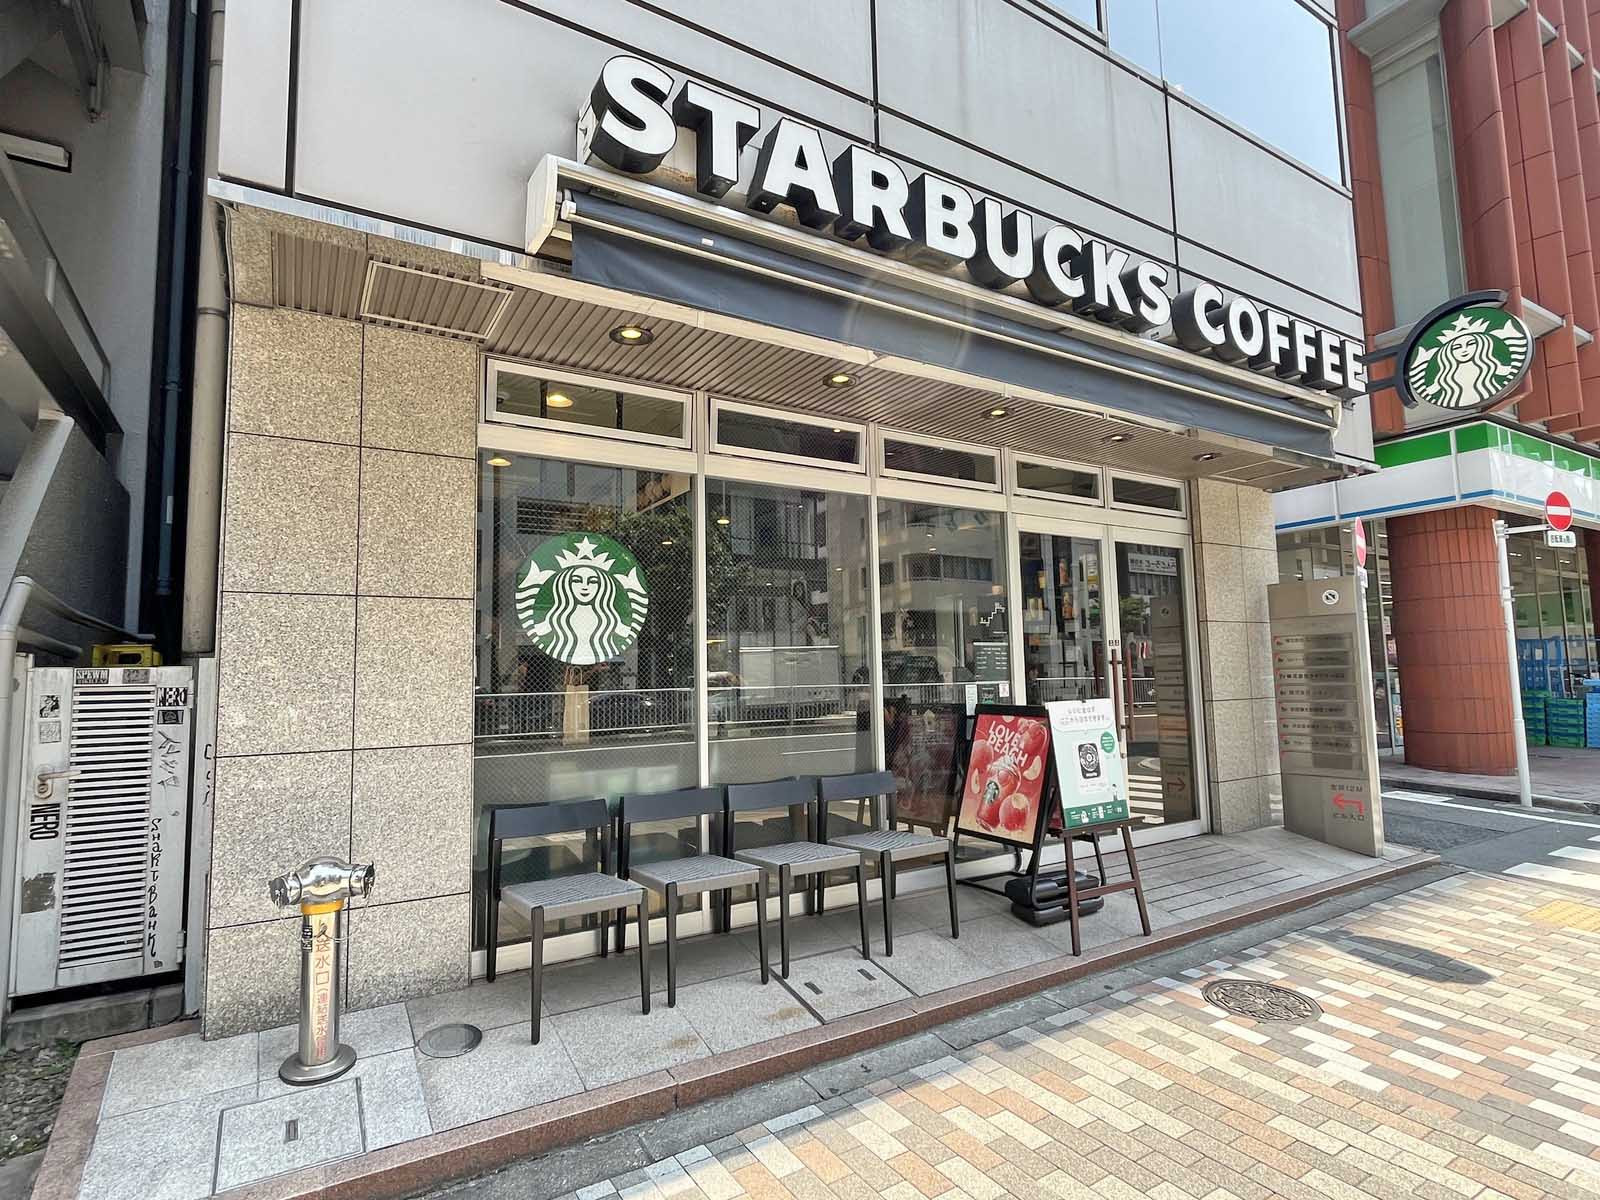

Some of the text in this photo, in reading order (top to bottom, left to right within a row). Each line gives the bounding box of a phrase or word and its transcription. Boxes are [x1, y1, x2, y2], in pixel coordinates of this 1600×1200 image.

[600, 54, 1368, 393] STARBUCKS COFFEE
[987, 734, 1029, 767] PEACH
[988, 721, 1025, 749] LOVE
[30, 803, 60, 840] NERO
